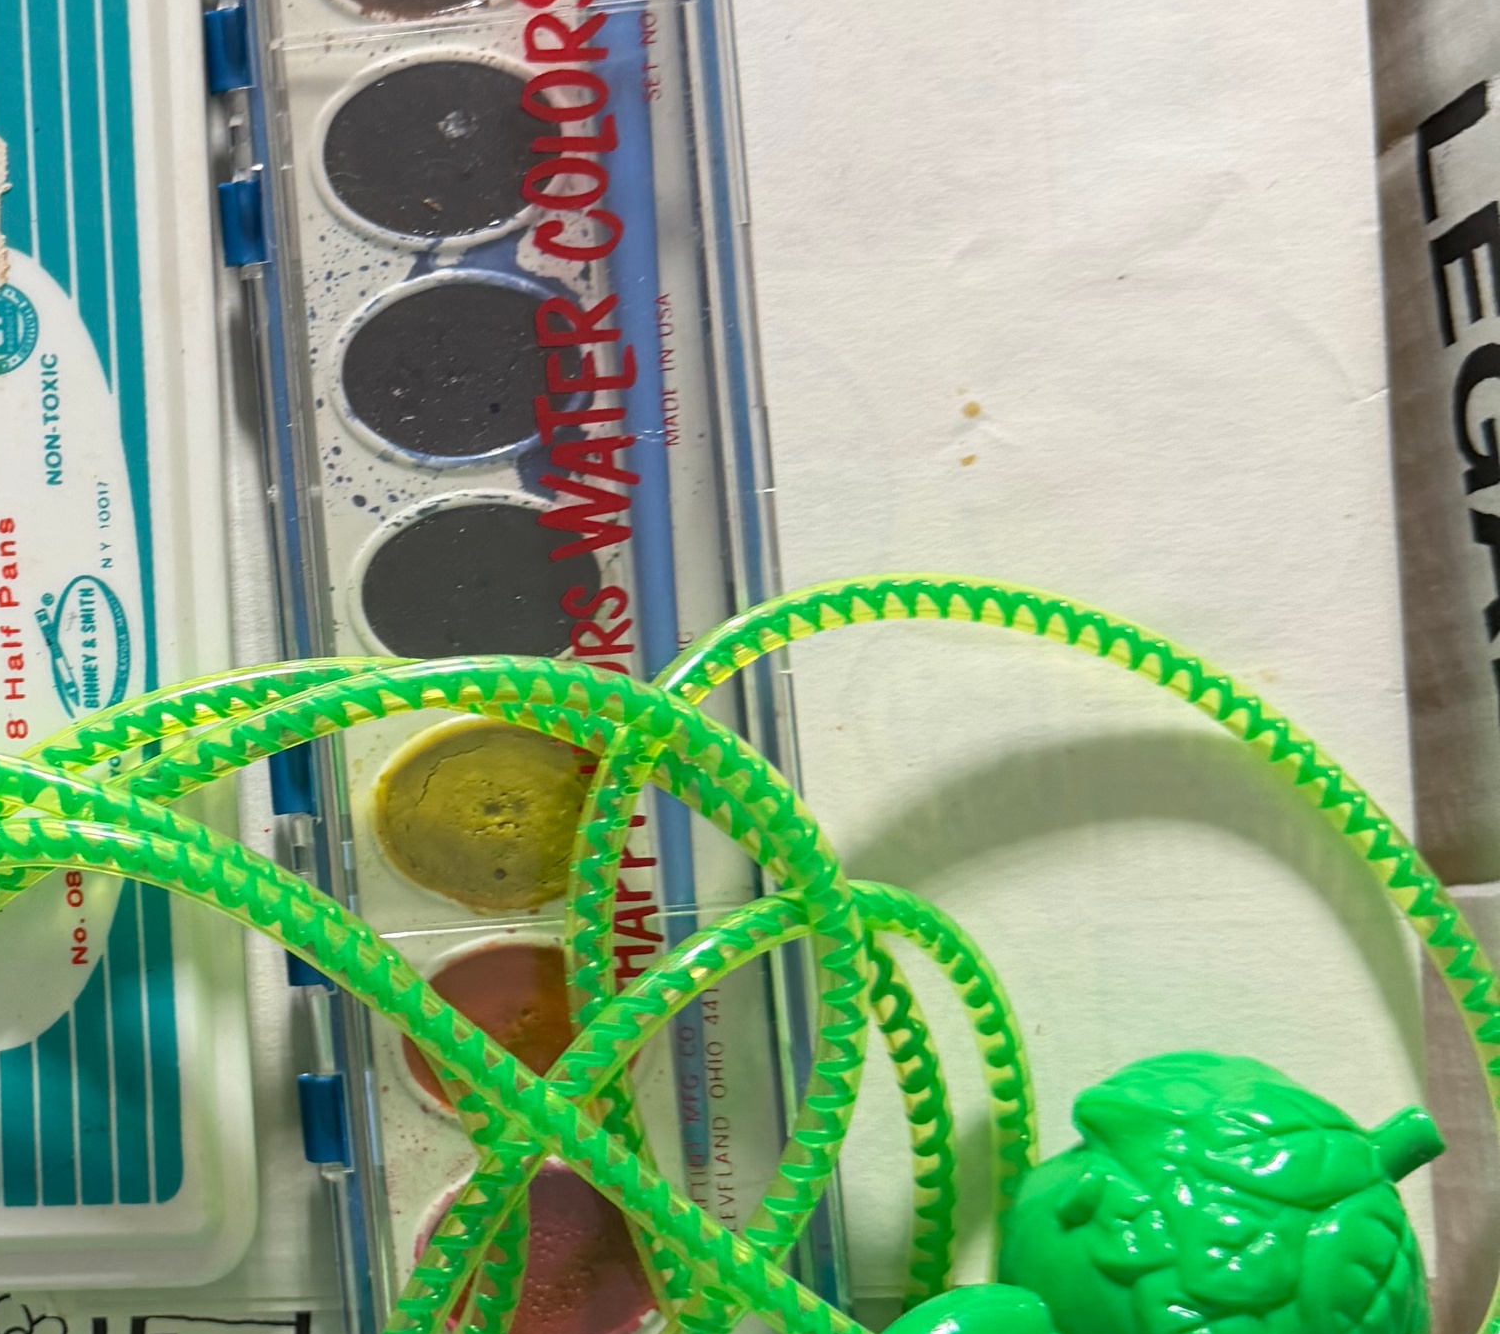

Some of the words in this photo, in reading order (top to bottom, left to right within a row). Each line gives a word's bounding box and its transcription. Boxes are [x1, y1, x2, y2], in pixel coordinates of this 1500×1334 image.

[640, 61, 661, 102] SET
[654, 292, 673, 337] USA
[39, 353, 63, 486] NON-TOXIC
[534, 292, 642, 562] WATER
[658, 376, 681, 448] MADE
[1415, 79, 1500, 732] LEG
[96, 480, 111, 530] 10017
[79, 586, 97, 634] SMITH
[0, 625, 25, 701] Half
[83, 635, 97, 651] &
[80, 651, 100, 709] BINNEY
[5, 718, 29, 740] 8
[69, 919, 89, 966] No.
[677, 1025, 697, 1058] CO
[704, 1040, 729, 1099] OHIO
[681, 1073, 701, 1123] MFG
[710, 1115, 739, 1234] LEVELAND
